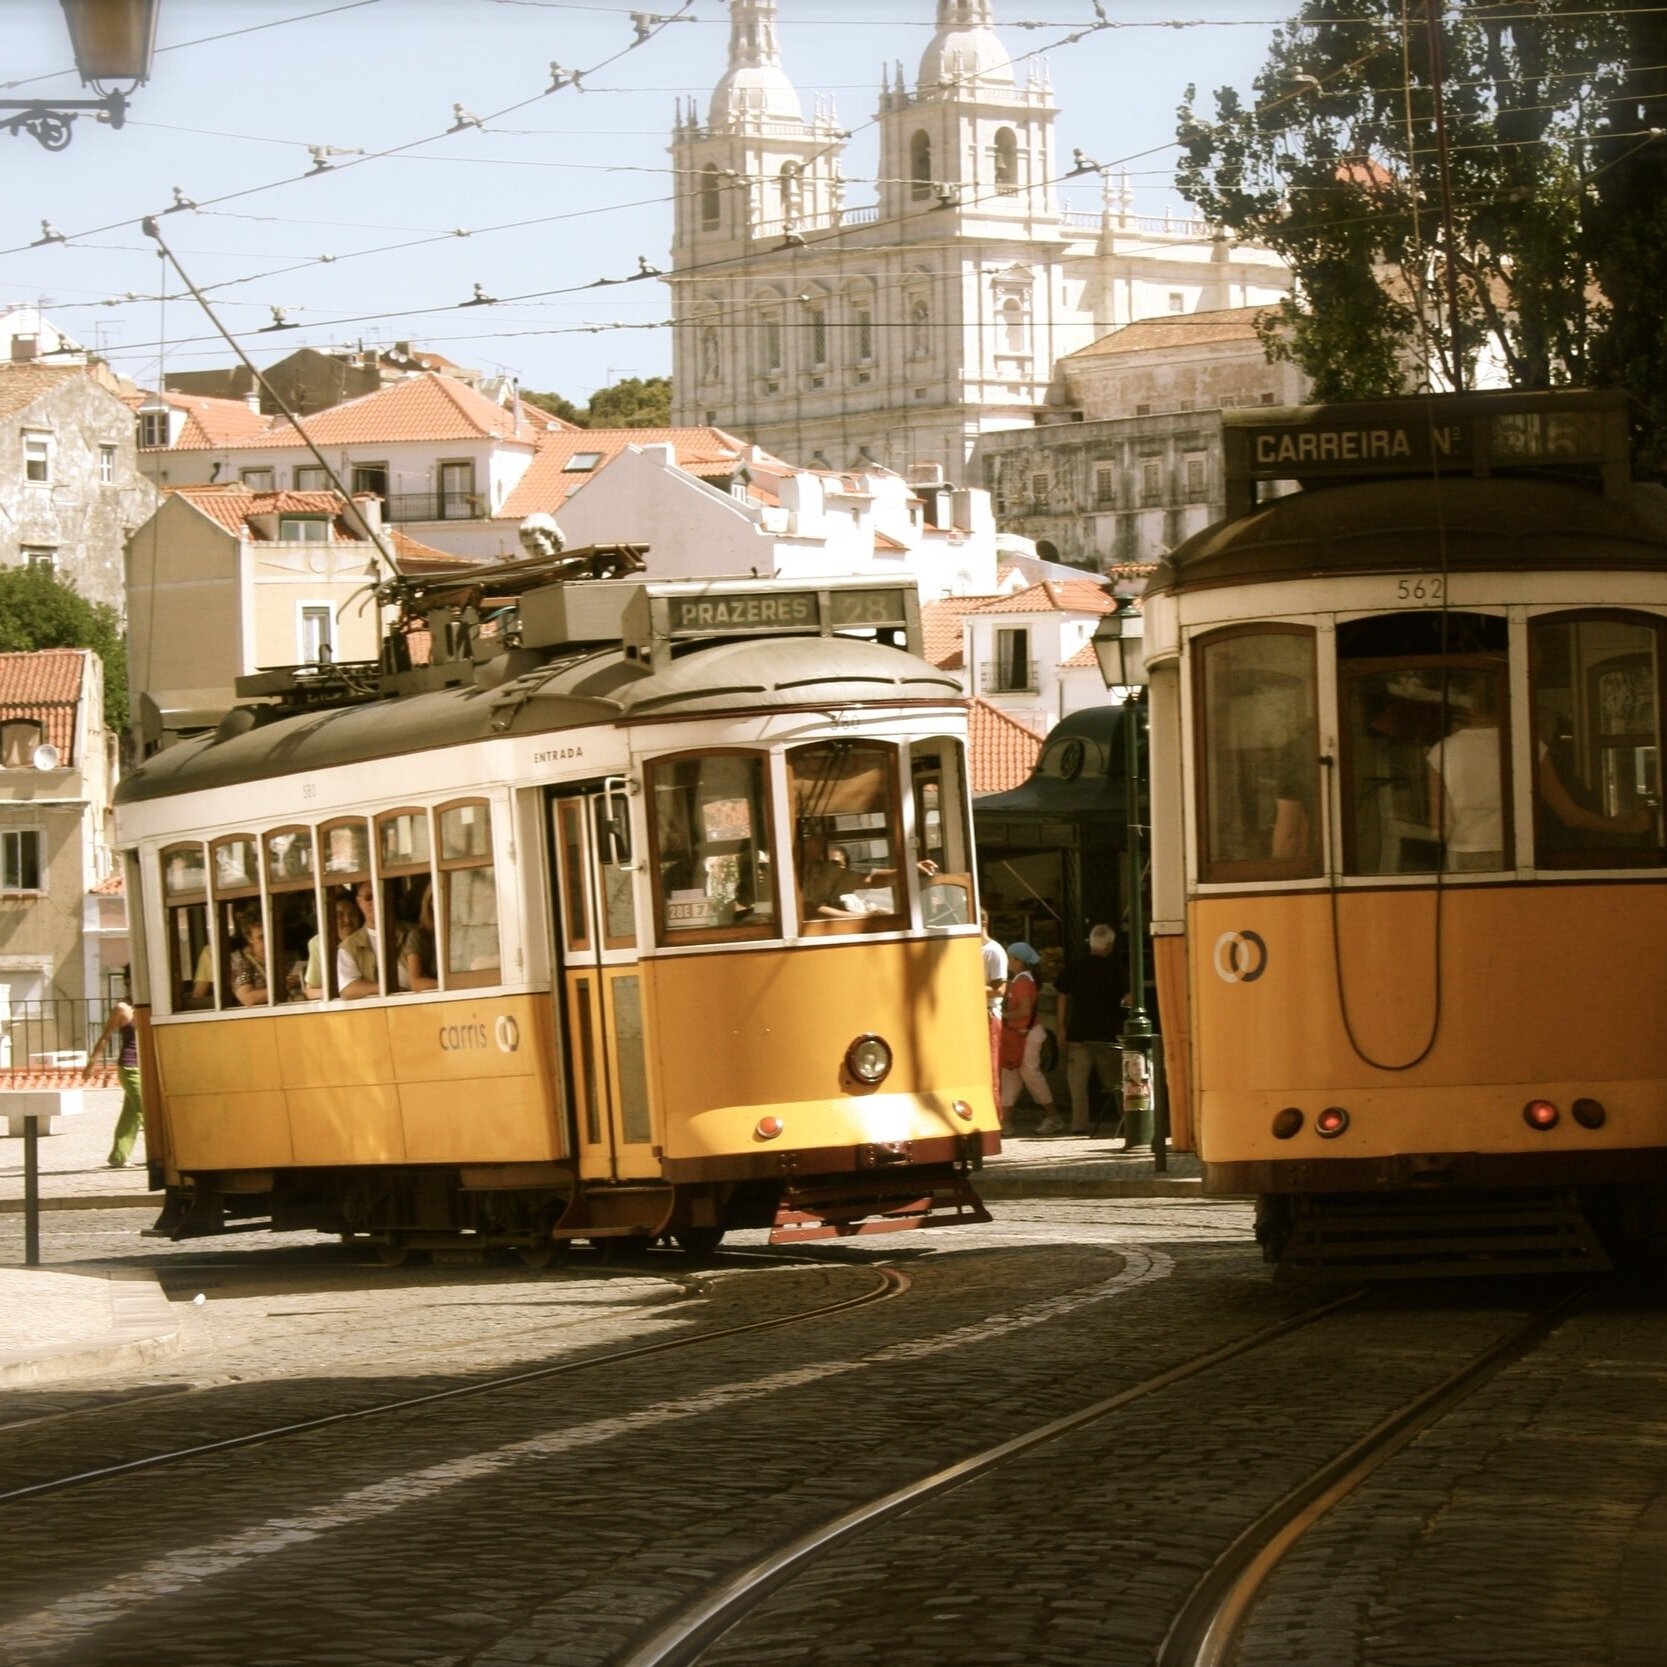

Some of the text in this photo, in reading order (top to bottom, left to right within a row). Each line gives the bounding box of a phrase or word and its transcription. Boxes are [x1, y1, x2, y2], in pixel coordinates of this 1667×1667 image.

[1256, 429, 1411, 464] CARREIRA
[1397, 578, 1444, 600] 562
[681, 595, 889, 625] PRAZERES 28
[533, 746, 583, 765] ENTRADA
[439, 1012, 487, 1051] carris
